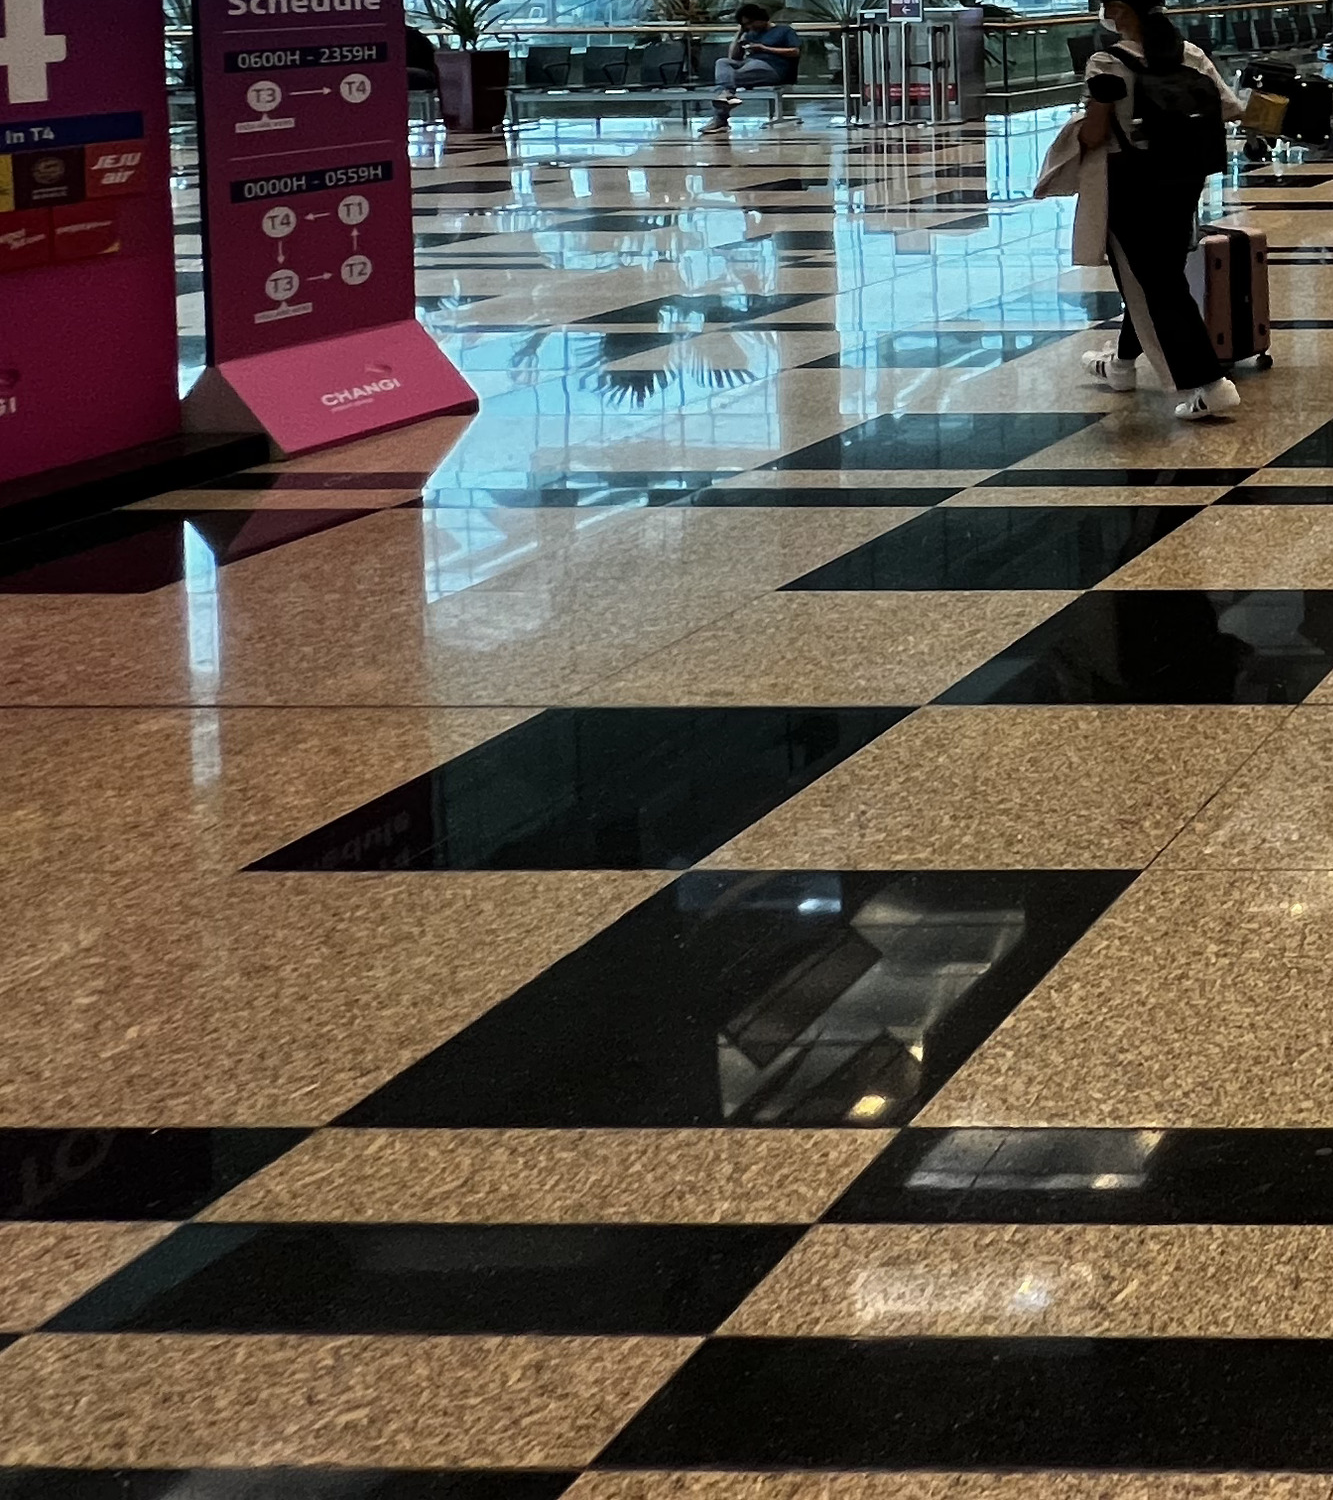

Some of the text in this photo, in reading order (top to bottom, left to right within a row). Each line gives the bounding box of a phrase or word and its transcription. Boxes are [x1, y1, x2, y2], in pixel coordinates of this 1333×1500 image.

[237, 50, 300, 69] 0600H
[319, 45, 377, 63] 2359H
[251, 80, 366, 104] T3 T4
[30, 125, 55, 141] T4
[244, 176, 307, 198] 0000H
[324, 164, 383, 186] 0559H
[266, 201, 364, 230] T4 T1
[269, 261, 368, 294] T3 T2
[320, 377, 402, 406] CHANGI
